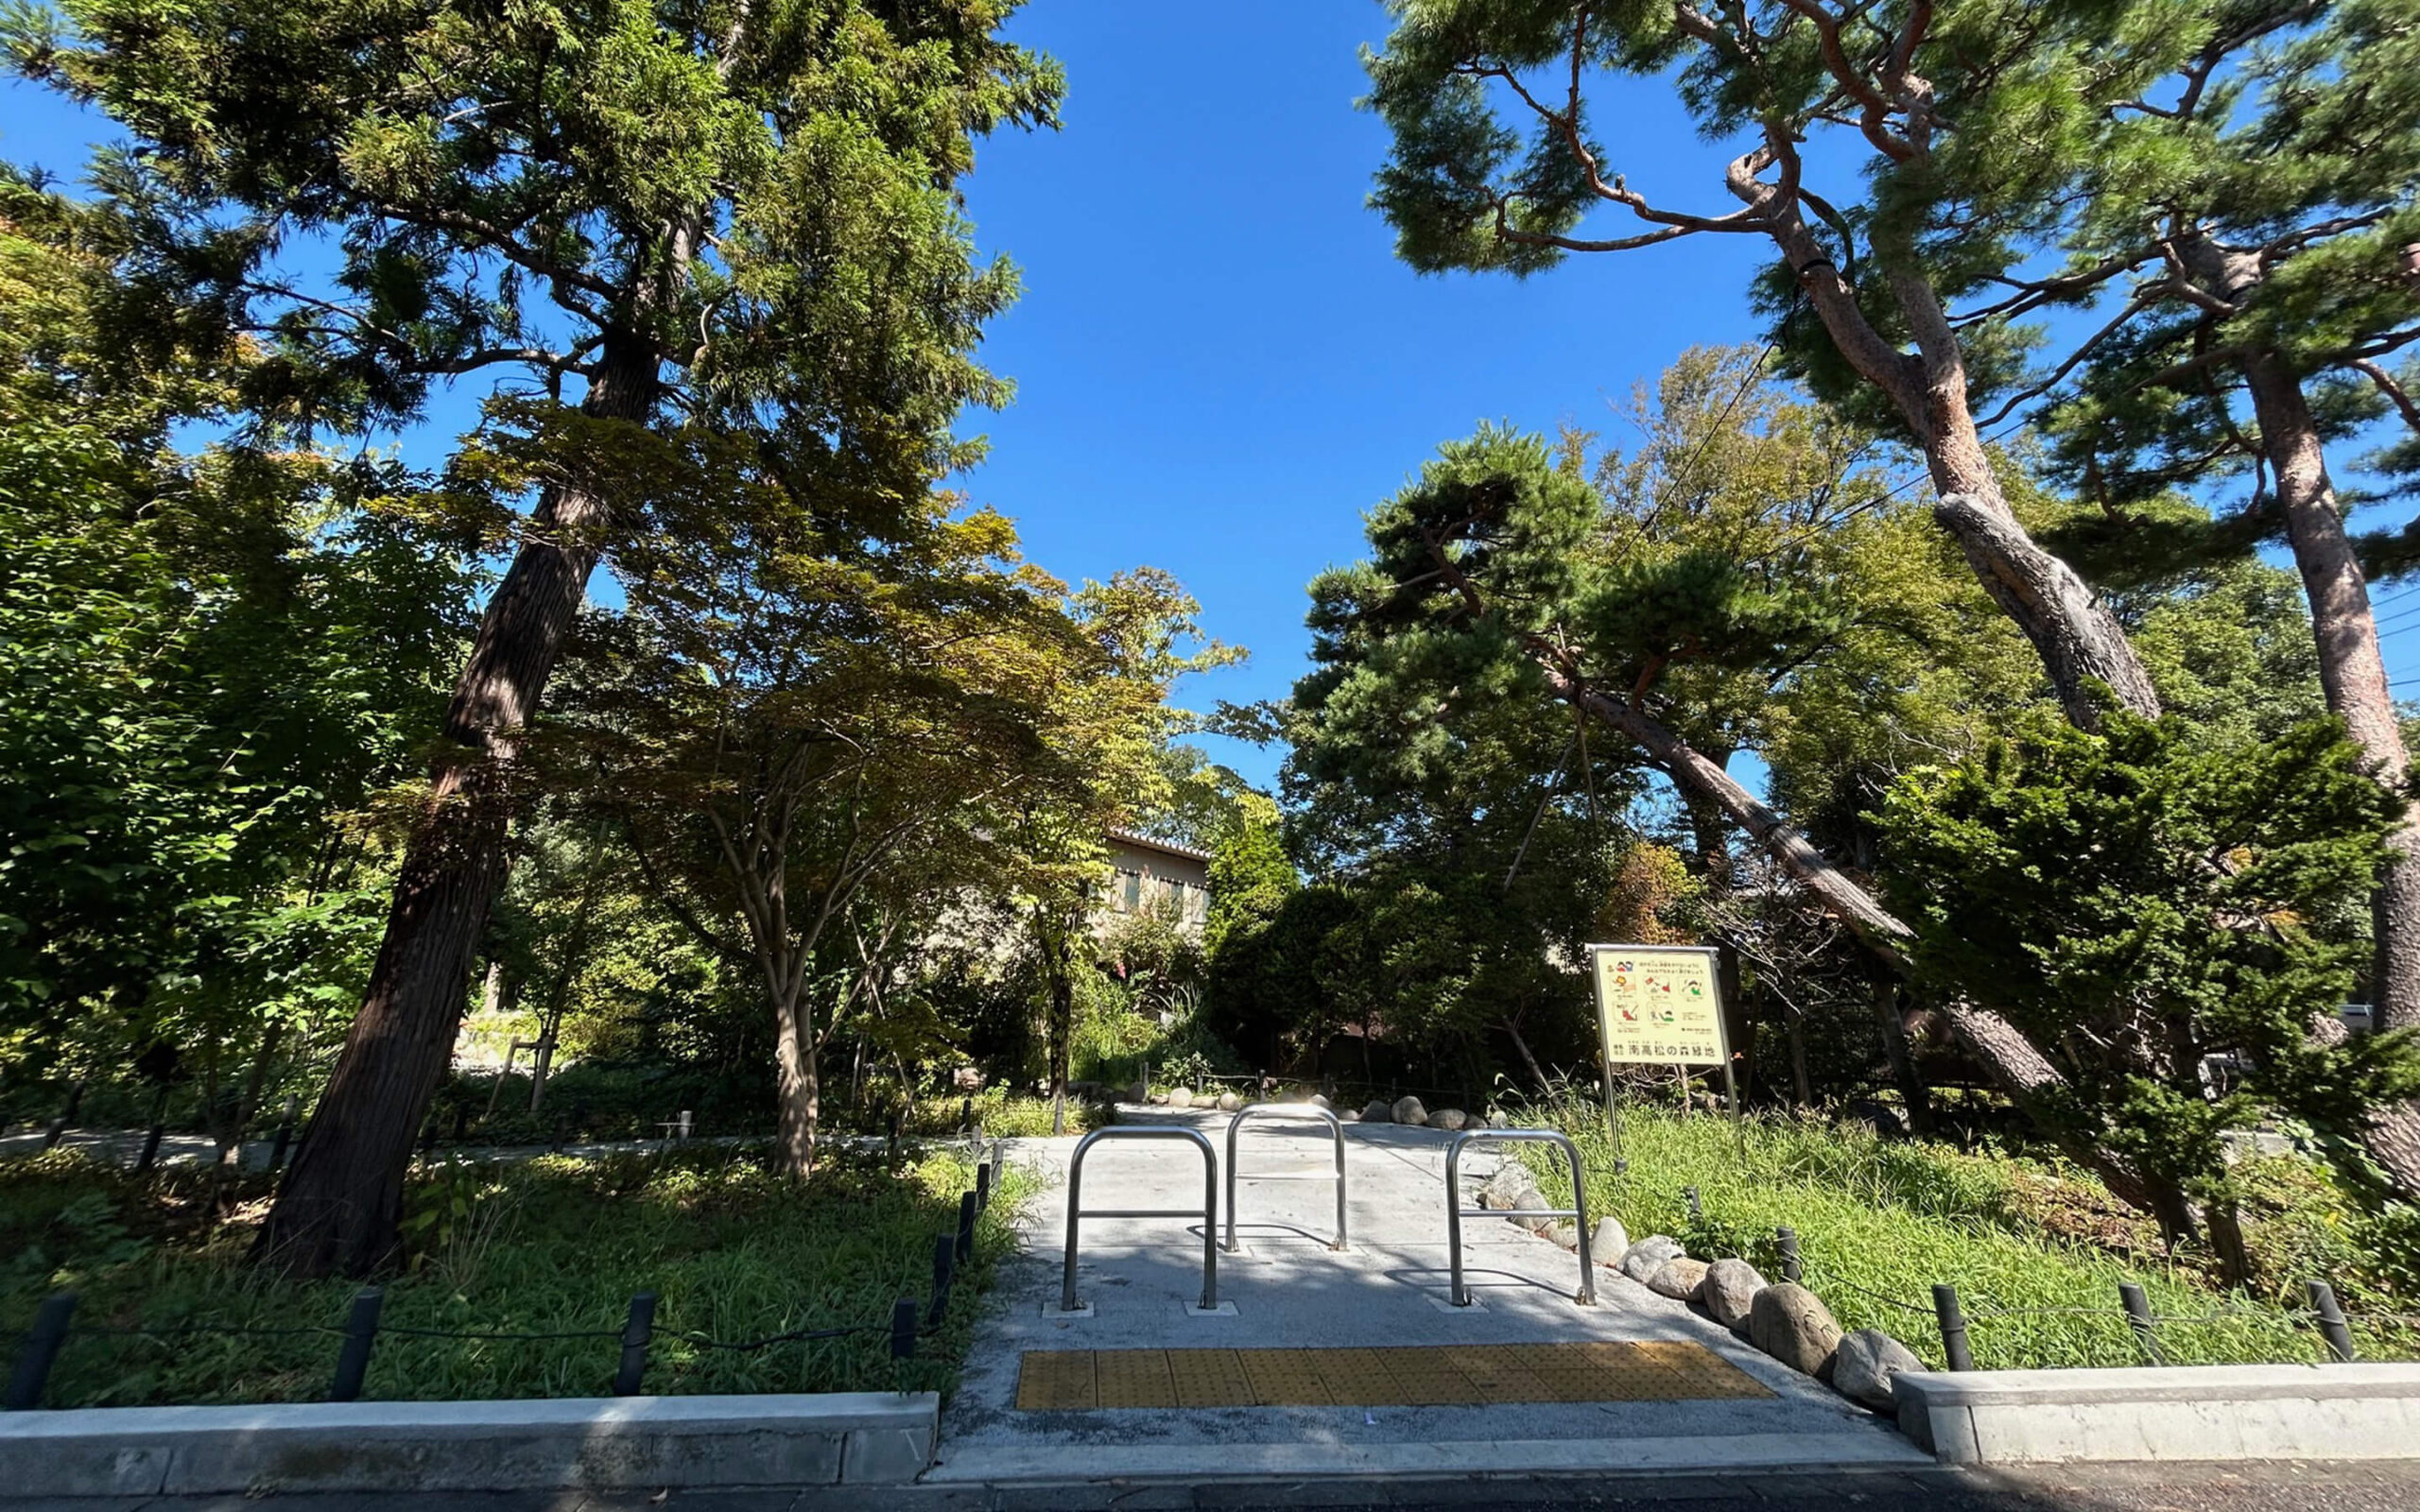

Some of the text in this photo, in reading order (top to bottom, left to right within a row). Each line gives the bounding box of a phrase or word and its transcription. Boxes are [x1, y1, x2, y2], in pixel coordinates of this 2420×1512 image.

[1629, 1045, 1716, 1057] 南高松の森緑地
